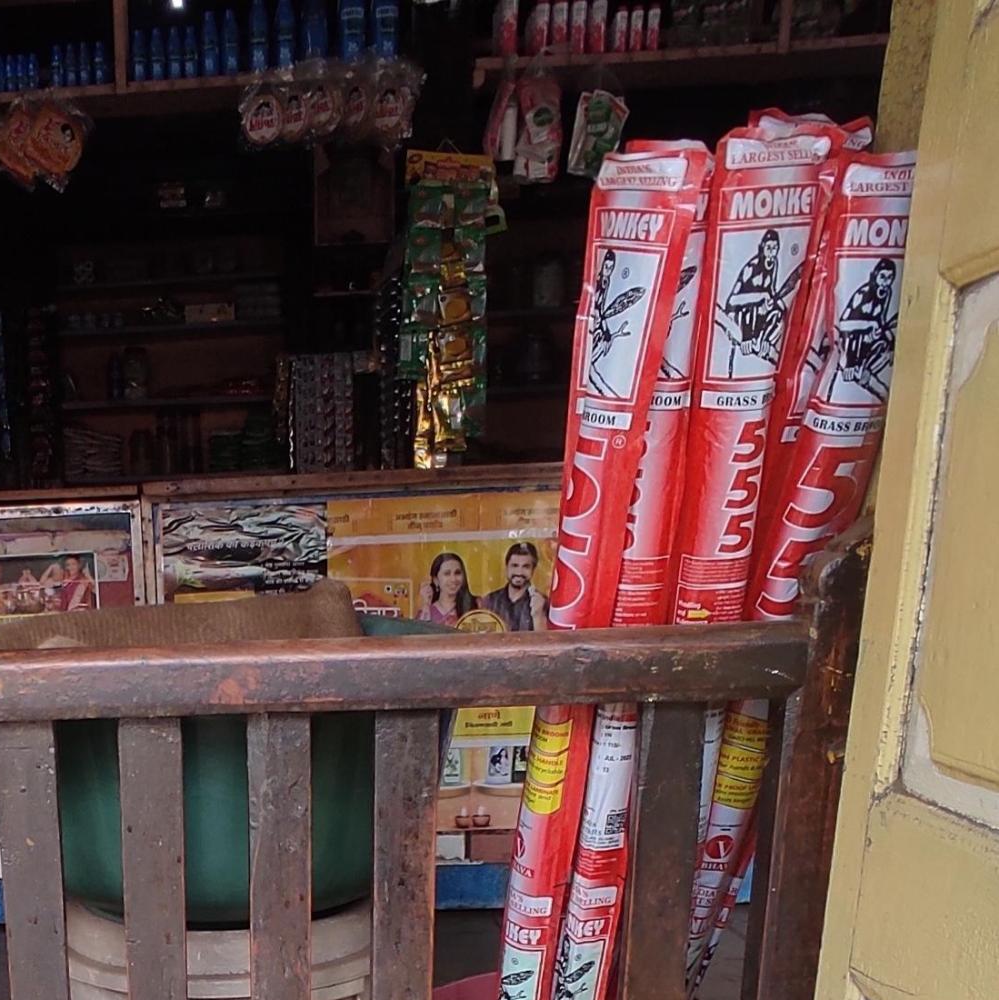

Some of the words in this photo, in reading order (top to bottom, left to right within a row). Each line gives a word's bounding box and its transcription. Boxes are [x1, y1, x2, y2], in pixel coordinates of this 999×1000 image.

[731, 150, 785, 165] LARGEST
[849, 181, 908, 193] LARGEST
[728, 185, 816, 221] MONKE
[842, 217, 909, 247] MON
[716, 395, 757, 407] GRASS
[812, 418, 850, 433] GRASS
